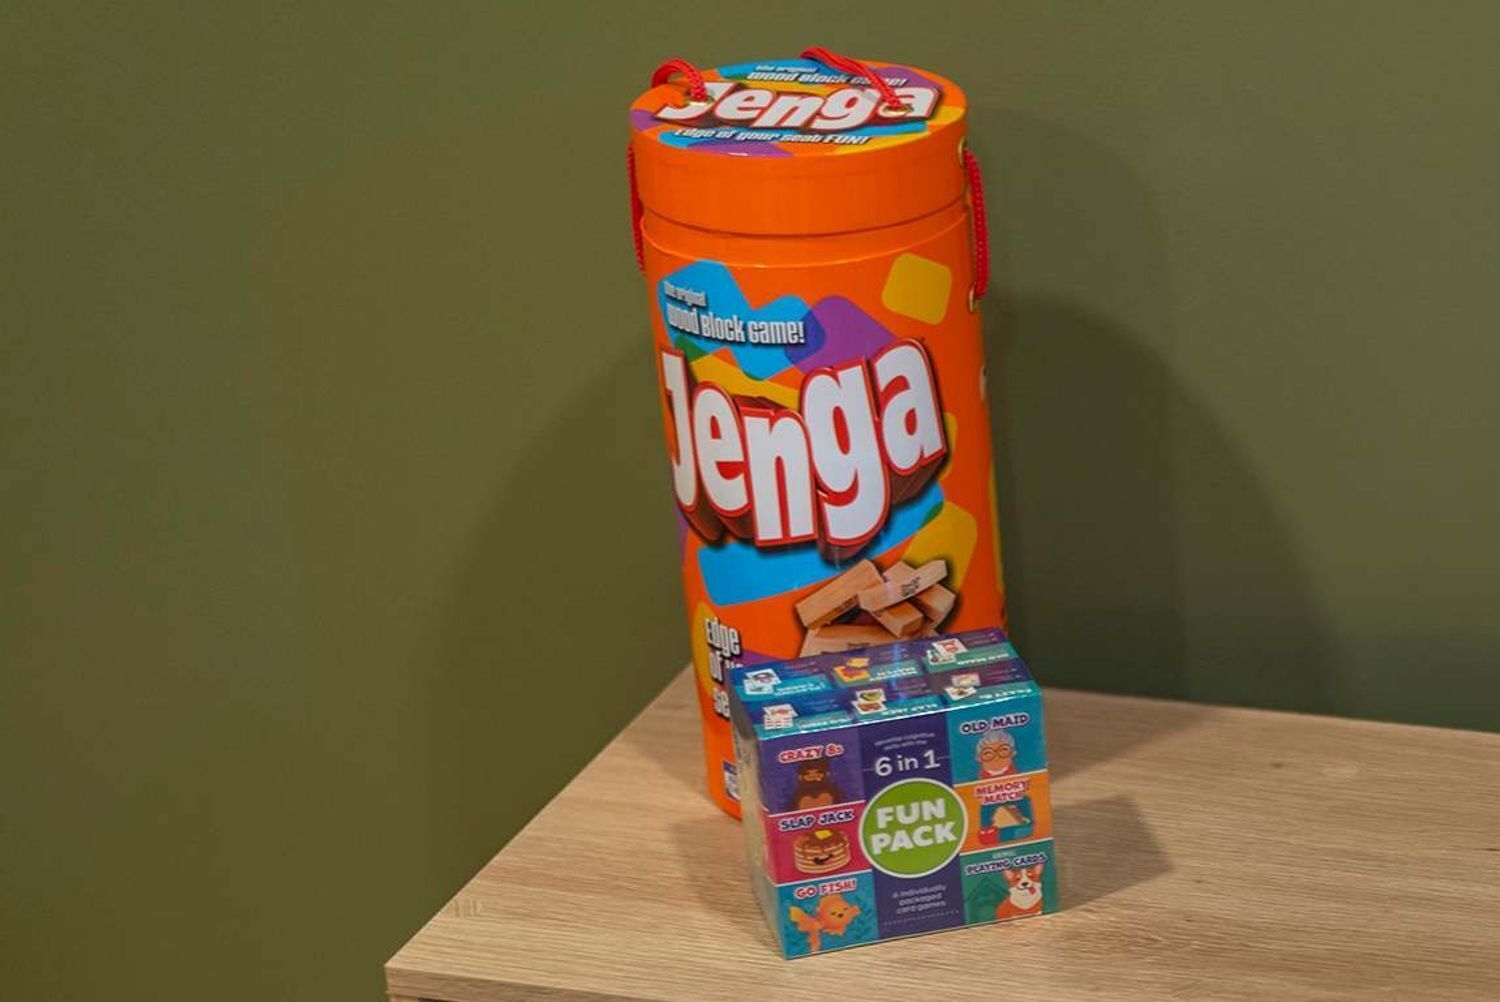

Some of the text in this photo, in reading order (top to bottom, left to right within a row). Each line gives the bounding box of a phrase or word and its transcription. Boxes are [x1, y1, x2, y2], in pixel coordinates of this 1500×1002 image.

[657, 81, 936, 128] Jenga
[661, 343, 944, 544] Jenga
[960, 712, 1030, 735] OLD MAID
[778, 745, 824, 763] CRAZY
[875, 749, 941, 776] 6 in 1
[974, 780, 1030, 796] MEMORY
[982, 791, 1024, 806] MATCH
[779, 809, 855, 831] SLAP JACK
[876, 798, 946, 829] FUN
[871, 821, 959, 855] PACK
[964, 859, 1011, 875] PLAYING
[1012, 853, 1047, 868] CARDS
[795, 878, 858, 900] GO FISH!
